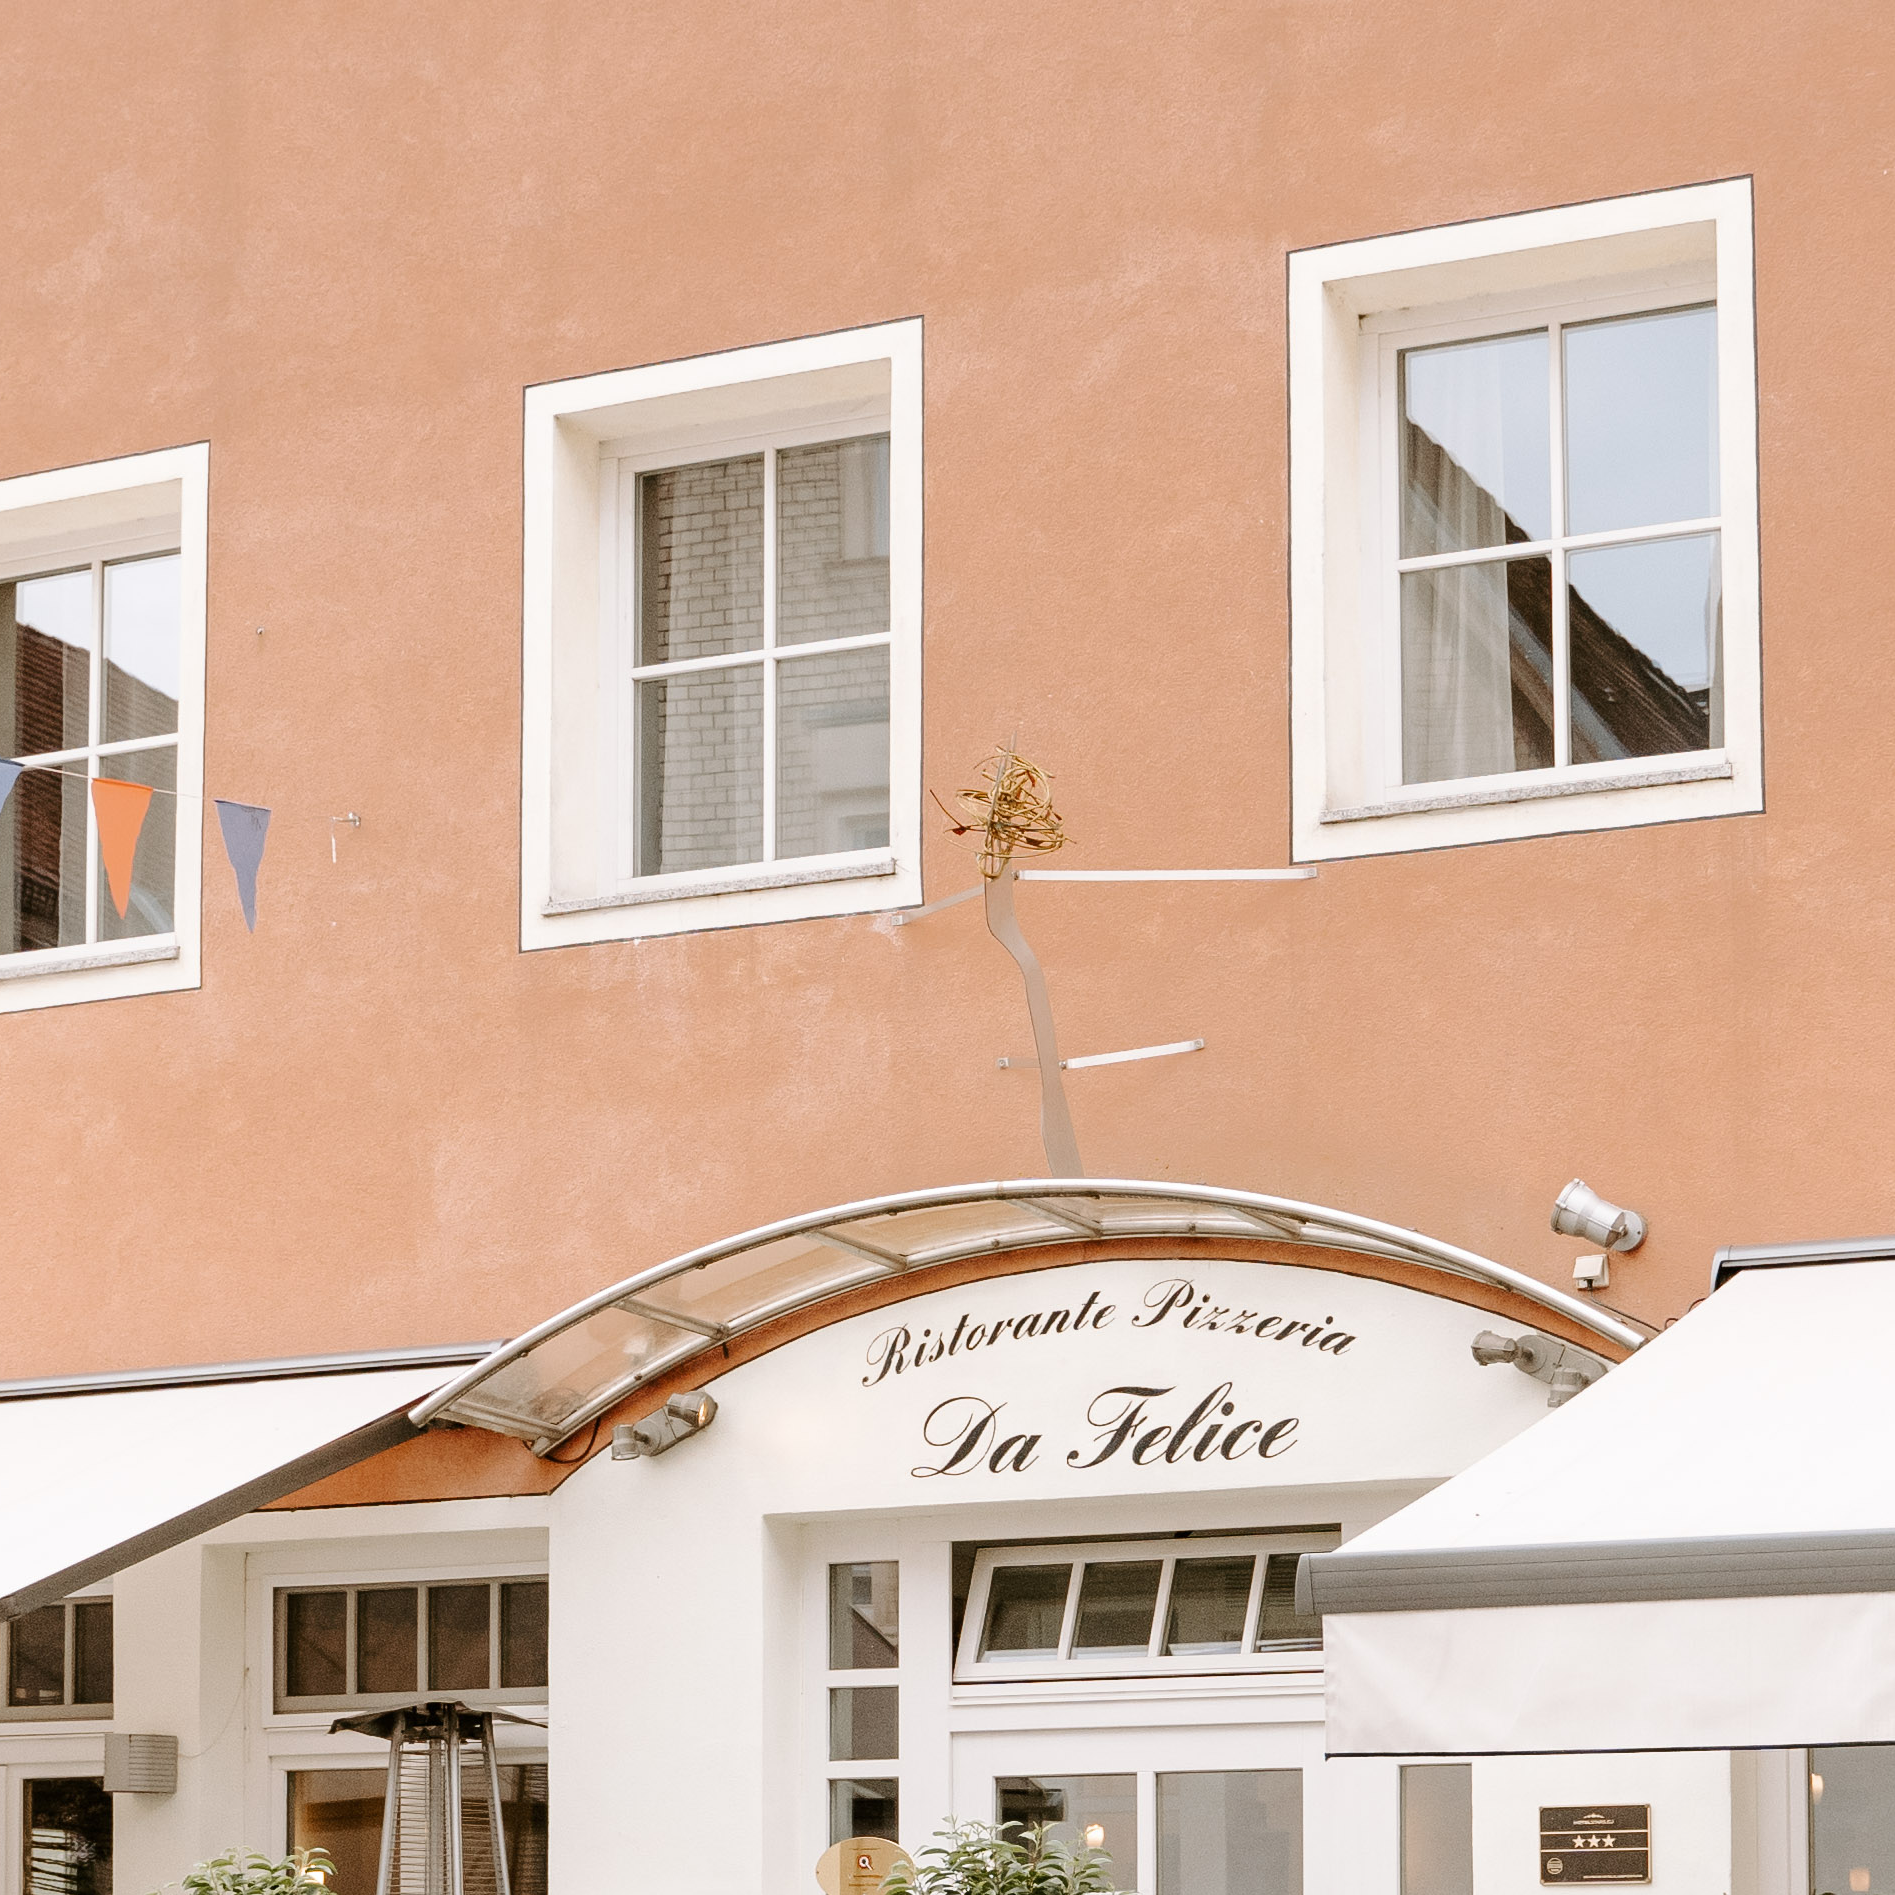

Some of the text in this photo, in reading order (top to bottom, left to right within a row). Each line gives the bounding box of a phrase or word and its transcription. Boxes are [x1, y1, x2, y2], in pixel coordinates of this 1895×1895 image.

[861, 1278, 1356, 1386] Ristorante Pizzeria
[910, 1381, 1300, 1478] Da Felice
